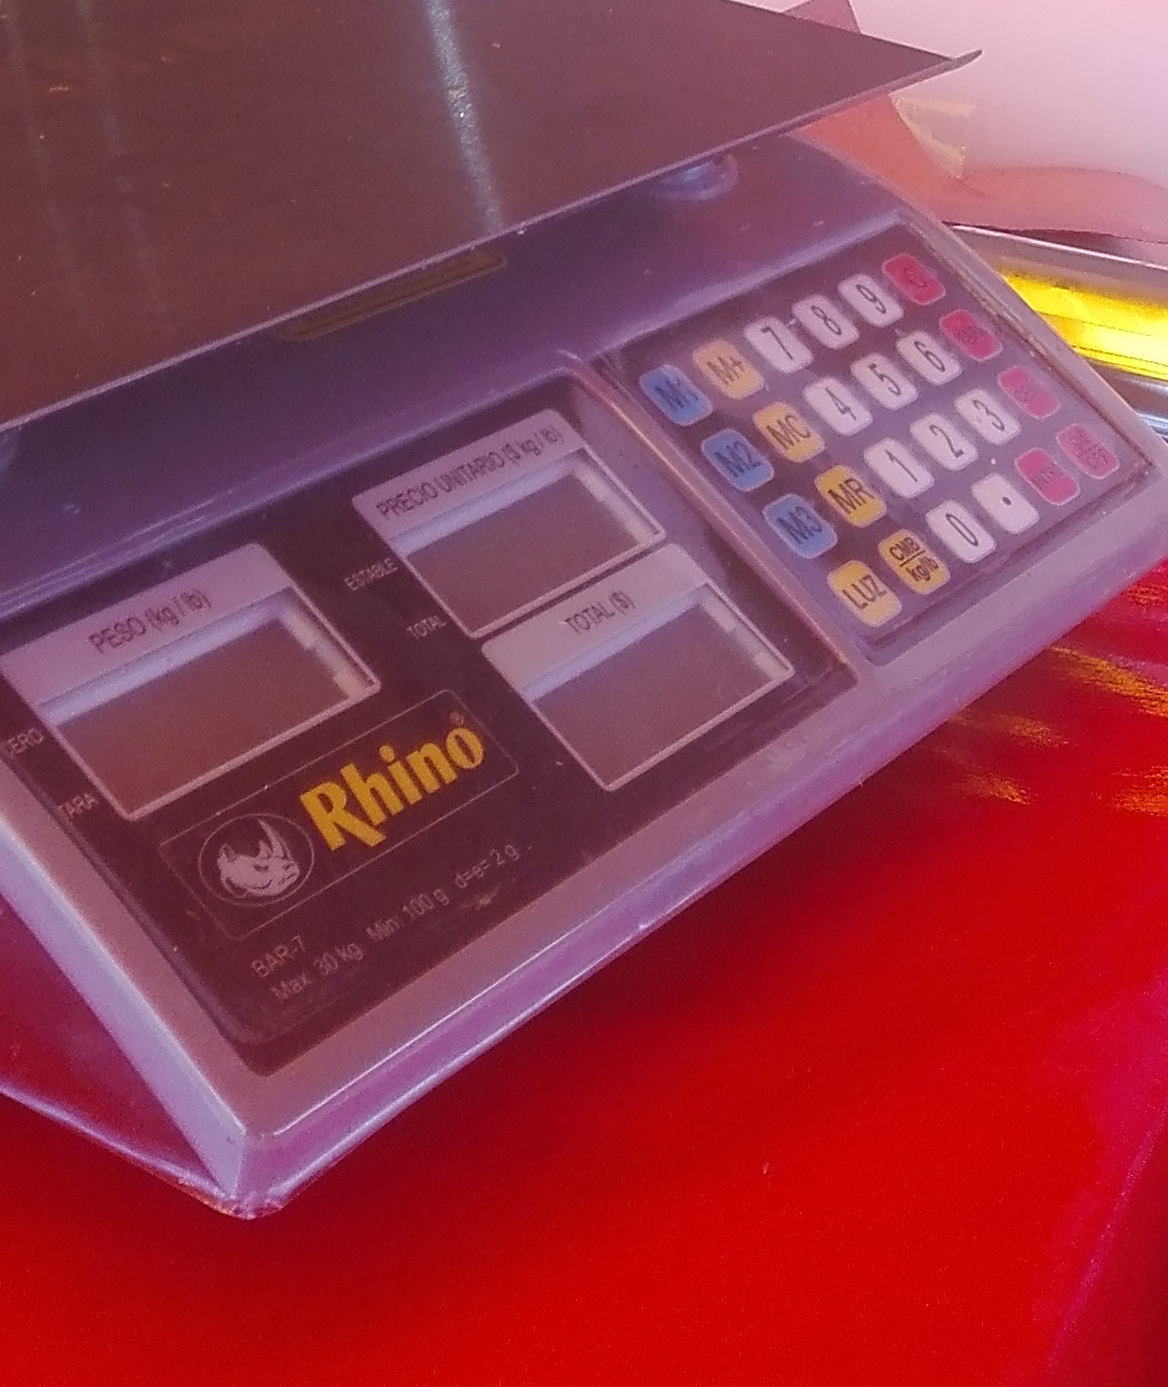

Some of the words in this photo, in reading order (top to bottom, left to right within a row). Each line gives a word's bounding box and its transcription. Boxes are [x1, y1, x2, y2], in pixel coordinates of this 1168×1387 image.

[856, 284, 887, 315] 9
[811, 305, 842, 336] 8
[761, 327, 793, 360] 7
[914, 341, 946, 372] 6
[706, 355, 745, 385] M+
[868, 363, 901, 396] 5
[825, 388, 857, 421] 4
[972, 399, 1005, 431] 3
[766, 414, 811, 450] MC
[929, 424, 964, 459] 2
[714, 441, 761, 478] M2
[885, 449, 918, 483] 1
[376, 482, 438, 520] PRECIO
[433, 450, 505, 493] UNITARIO
[828, 478, 876, 514] MR
[777, 505, 824, 544] M3
[344, 558, 399, 591] ESTABLE
[842, 574, 888, 610] LUZ
[405, 615, 447, 639] TOTAL
[565, 601, 615, 634] TOTAL
[89, 617, 147, 654] PESO
[299, 726, 485, 851] Rhino
[313, 953, 338, 976] 30
[334, 942, 364, 961] kg
[403, 894, 434, 918] 100
[434, 888, 450, 906] g
[251, 935, 305, 978] BAR-7
